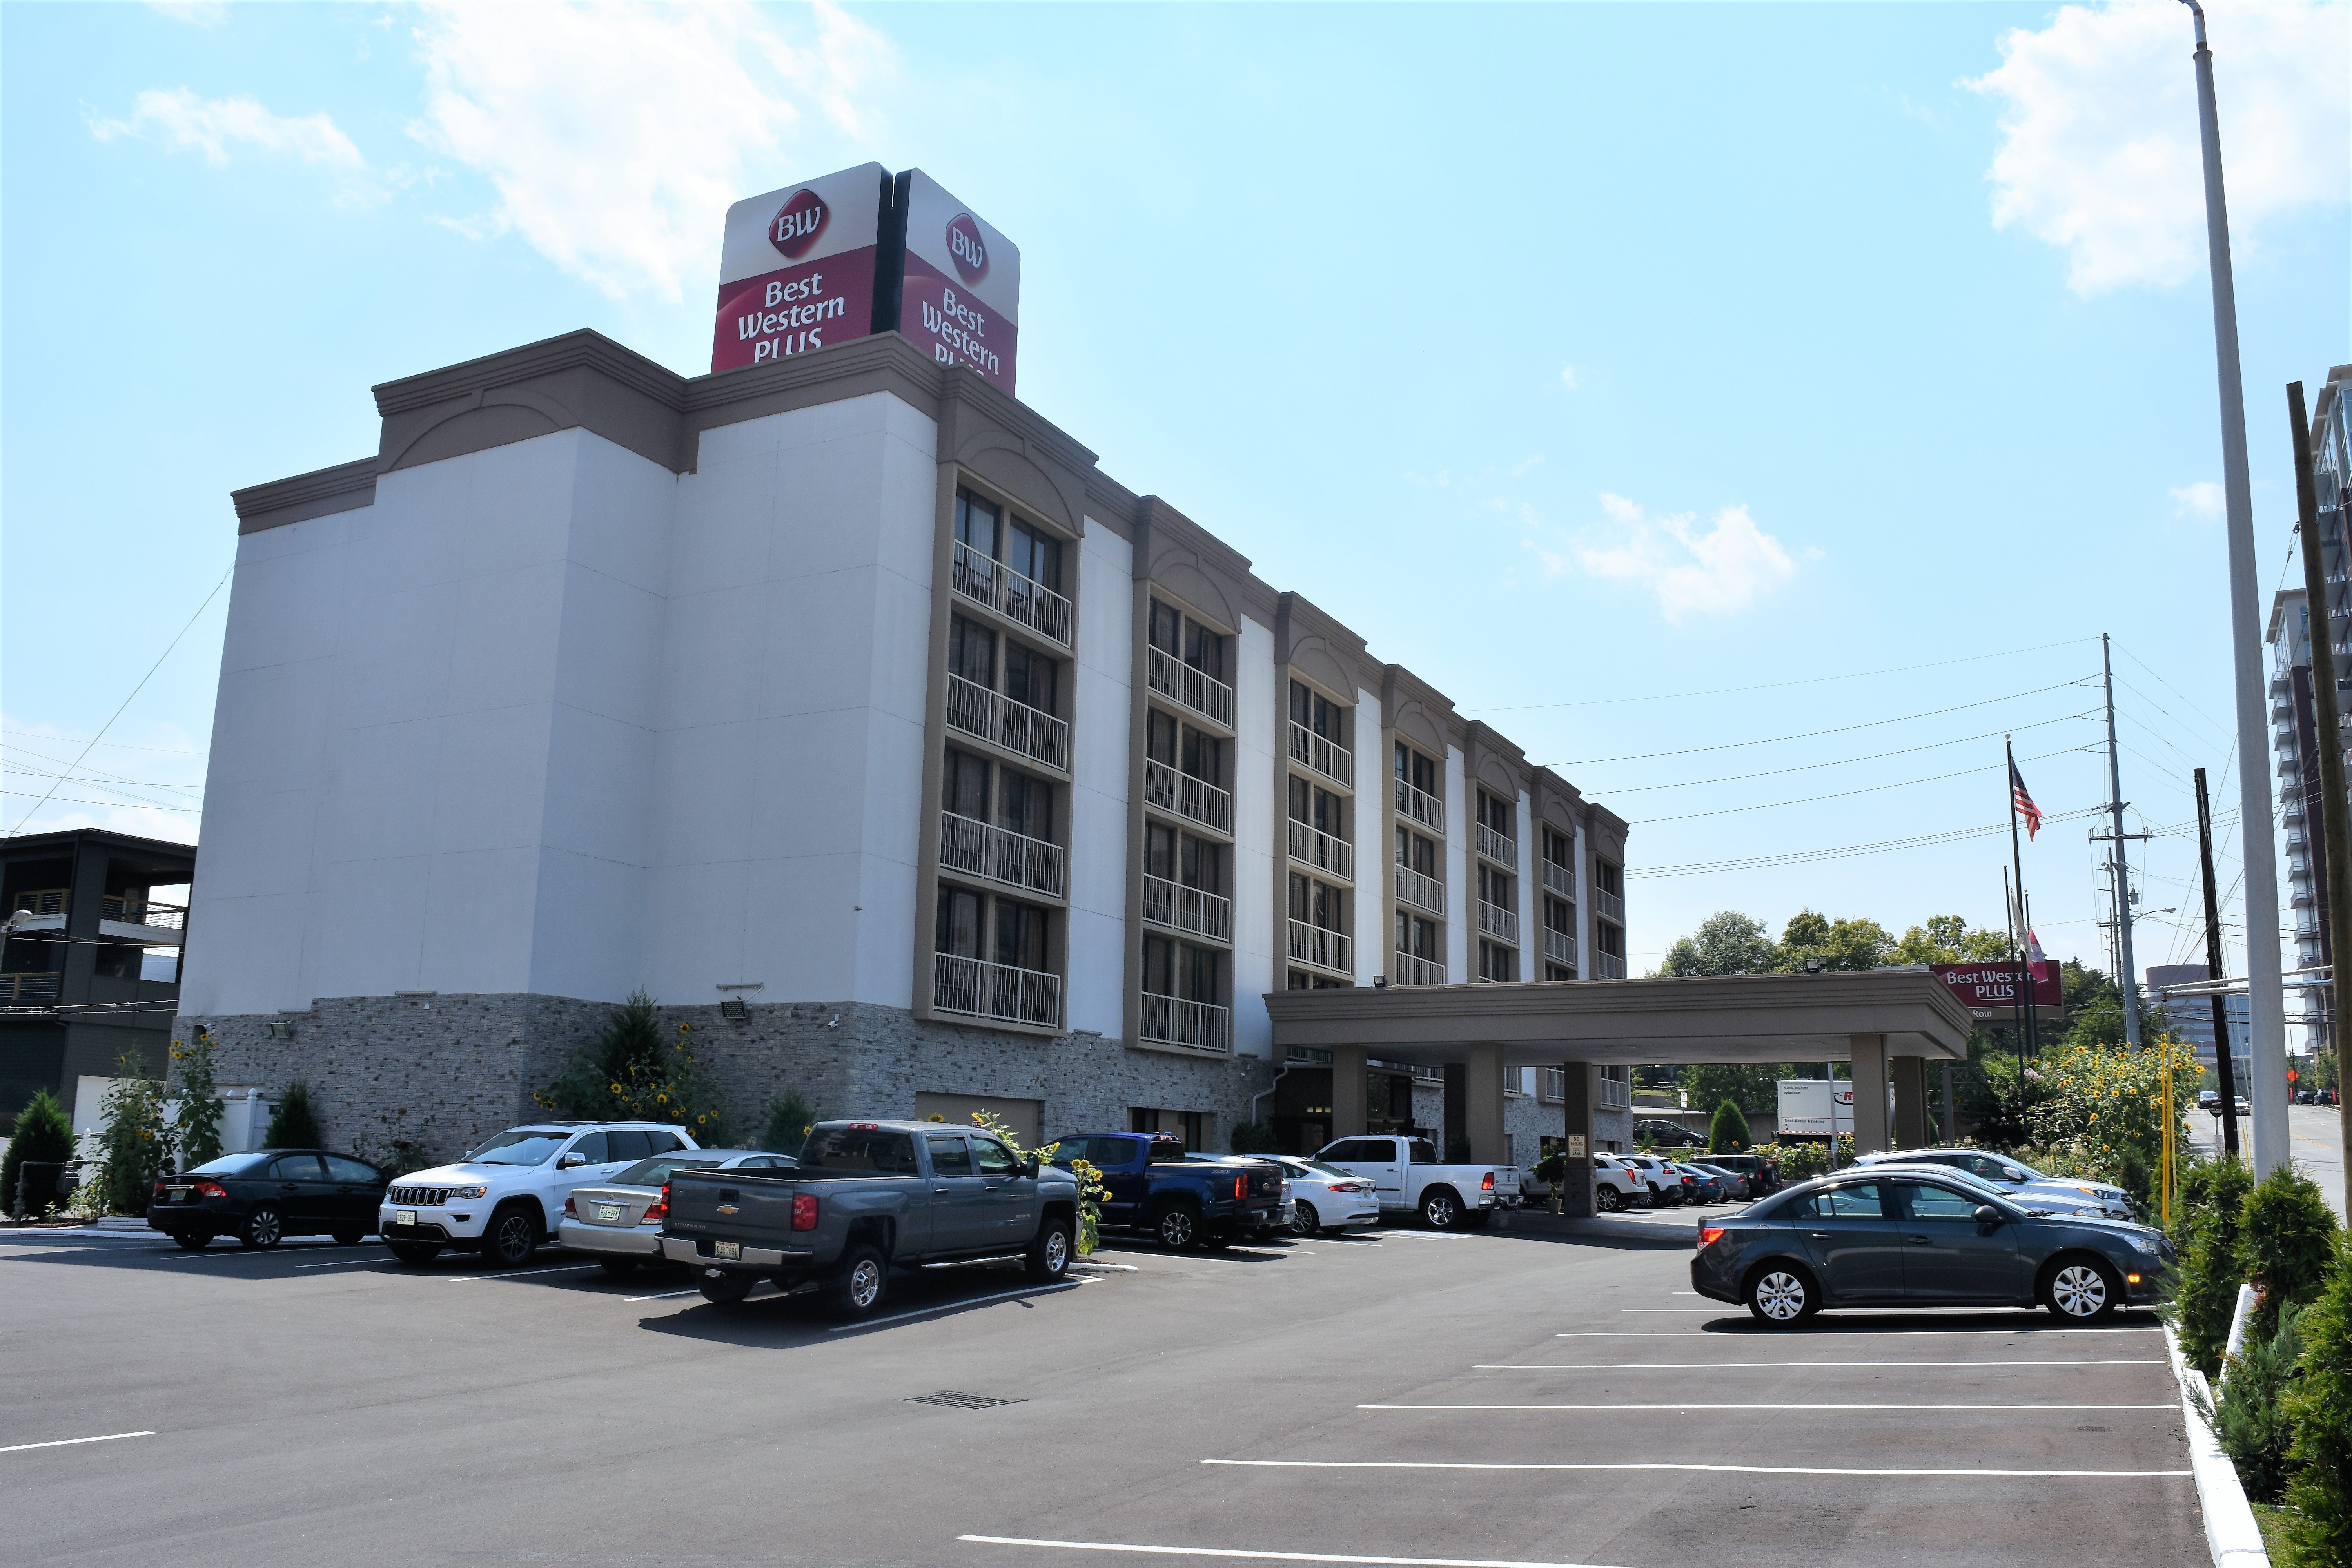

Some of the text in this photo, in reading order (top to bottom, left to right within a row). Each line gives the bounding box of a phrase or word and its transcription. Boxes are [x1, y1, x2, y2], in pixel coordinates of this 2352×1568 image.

[777, 206, 821, 242] BW
[951, 227, 983, 269] BW
[765, 273, 823, 307] Best
[739, 296, 845, 341] Western
[943, 287, 984, 338] Best
[922, 300, 999, 376] Western
[1947, 972, 1979, 984] Best
[1976, 984, 2014, 998] PLUS
[726, 1247, 737, 1255] 7691
